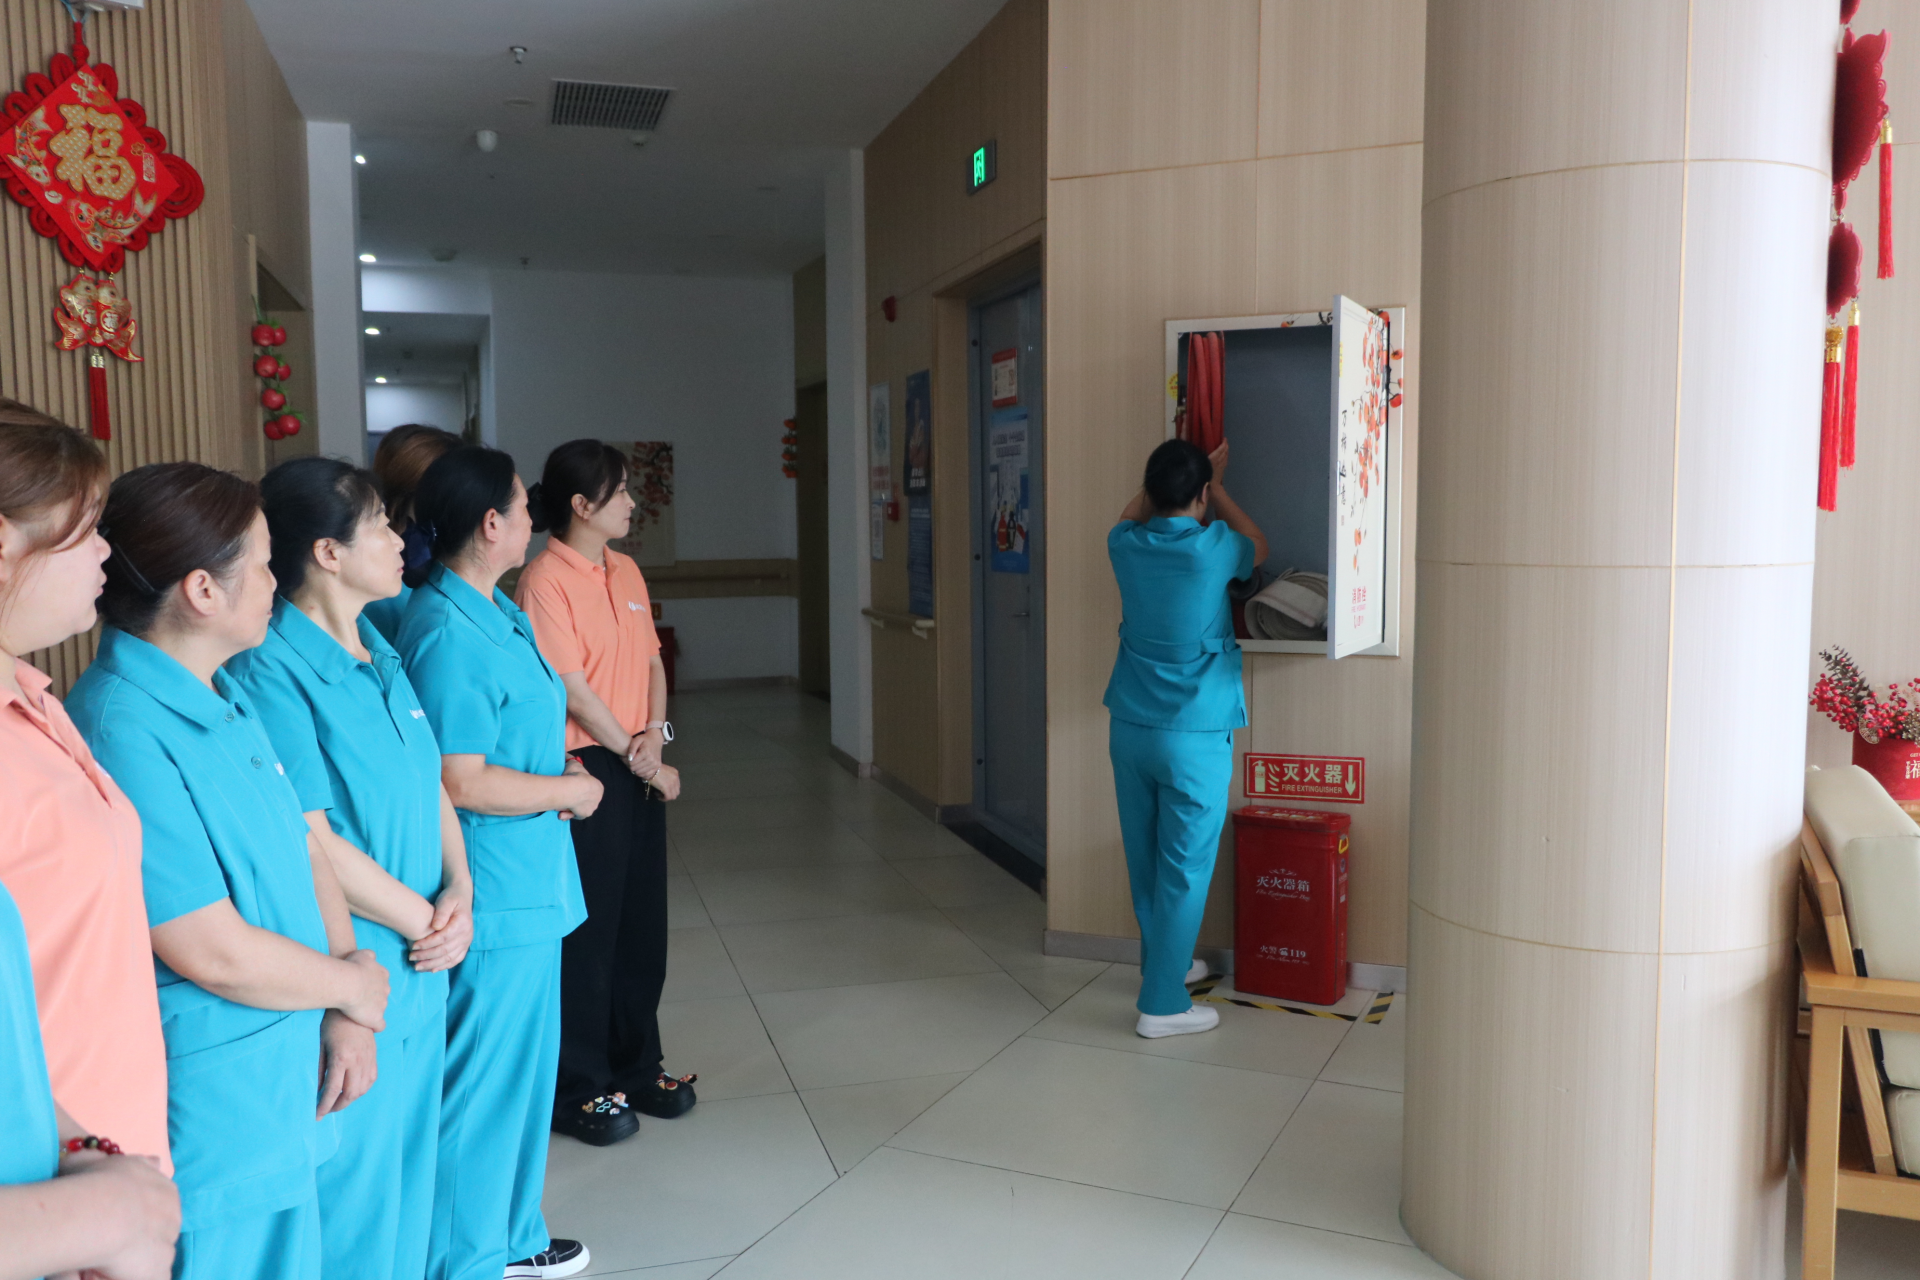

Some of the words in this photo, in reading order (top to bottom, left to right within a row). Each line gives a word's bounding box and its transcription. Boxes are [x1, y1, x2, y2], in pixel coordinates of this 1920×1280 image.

[49, 103, 136, 200] 福
[1282, 763, 1343, 784] 灭火器
[1281, 784, 1296, 792] FIRE
[1297, 785, 1343, 794] EXTINGUISHER
[1256, 876, 1310, 892] 灭火器箱
[1290, 949, 1307, 958] 119
